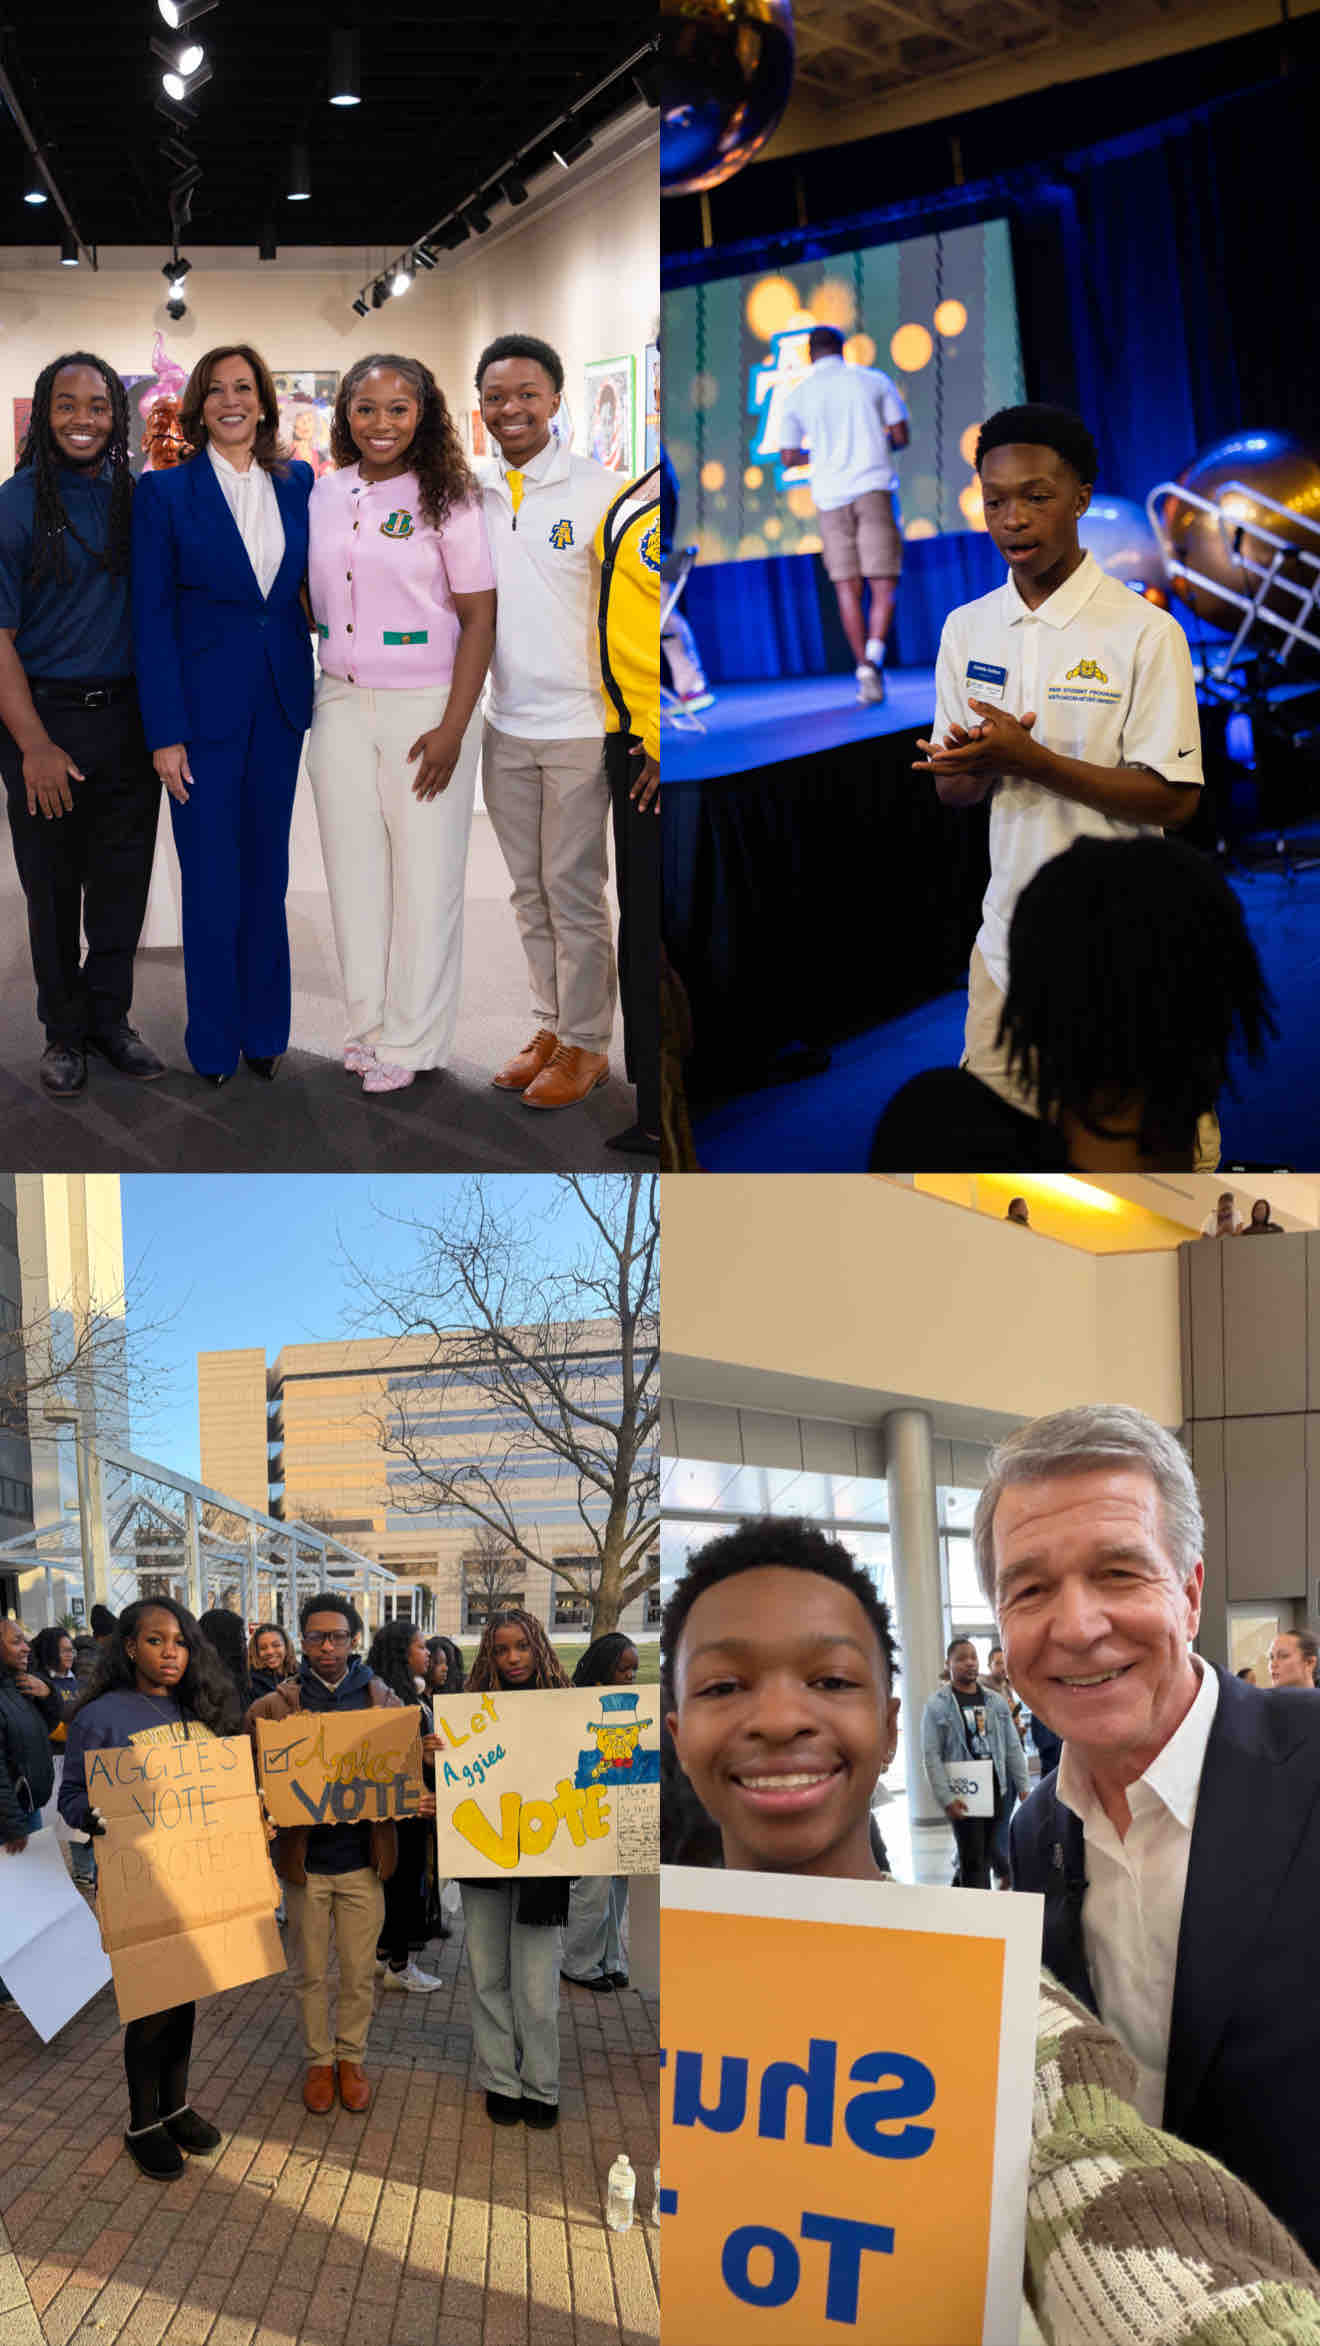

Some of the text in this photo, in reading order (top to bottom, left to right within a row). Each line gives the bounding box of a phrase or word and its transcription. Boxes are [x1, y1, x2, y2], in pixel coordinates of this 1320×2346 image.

[439, 1693, 499, 1748] Let
[88, 1738, 238, 1786] AGGIES
[443, 1744, 506, 1787] Aggies
[132, 1784, 218, 1829] VOTE
[289, 1773, 421, 1823] VOTE
